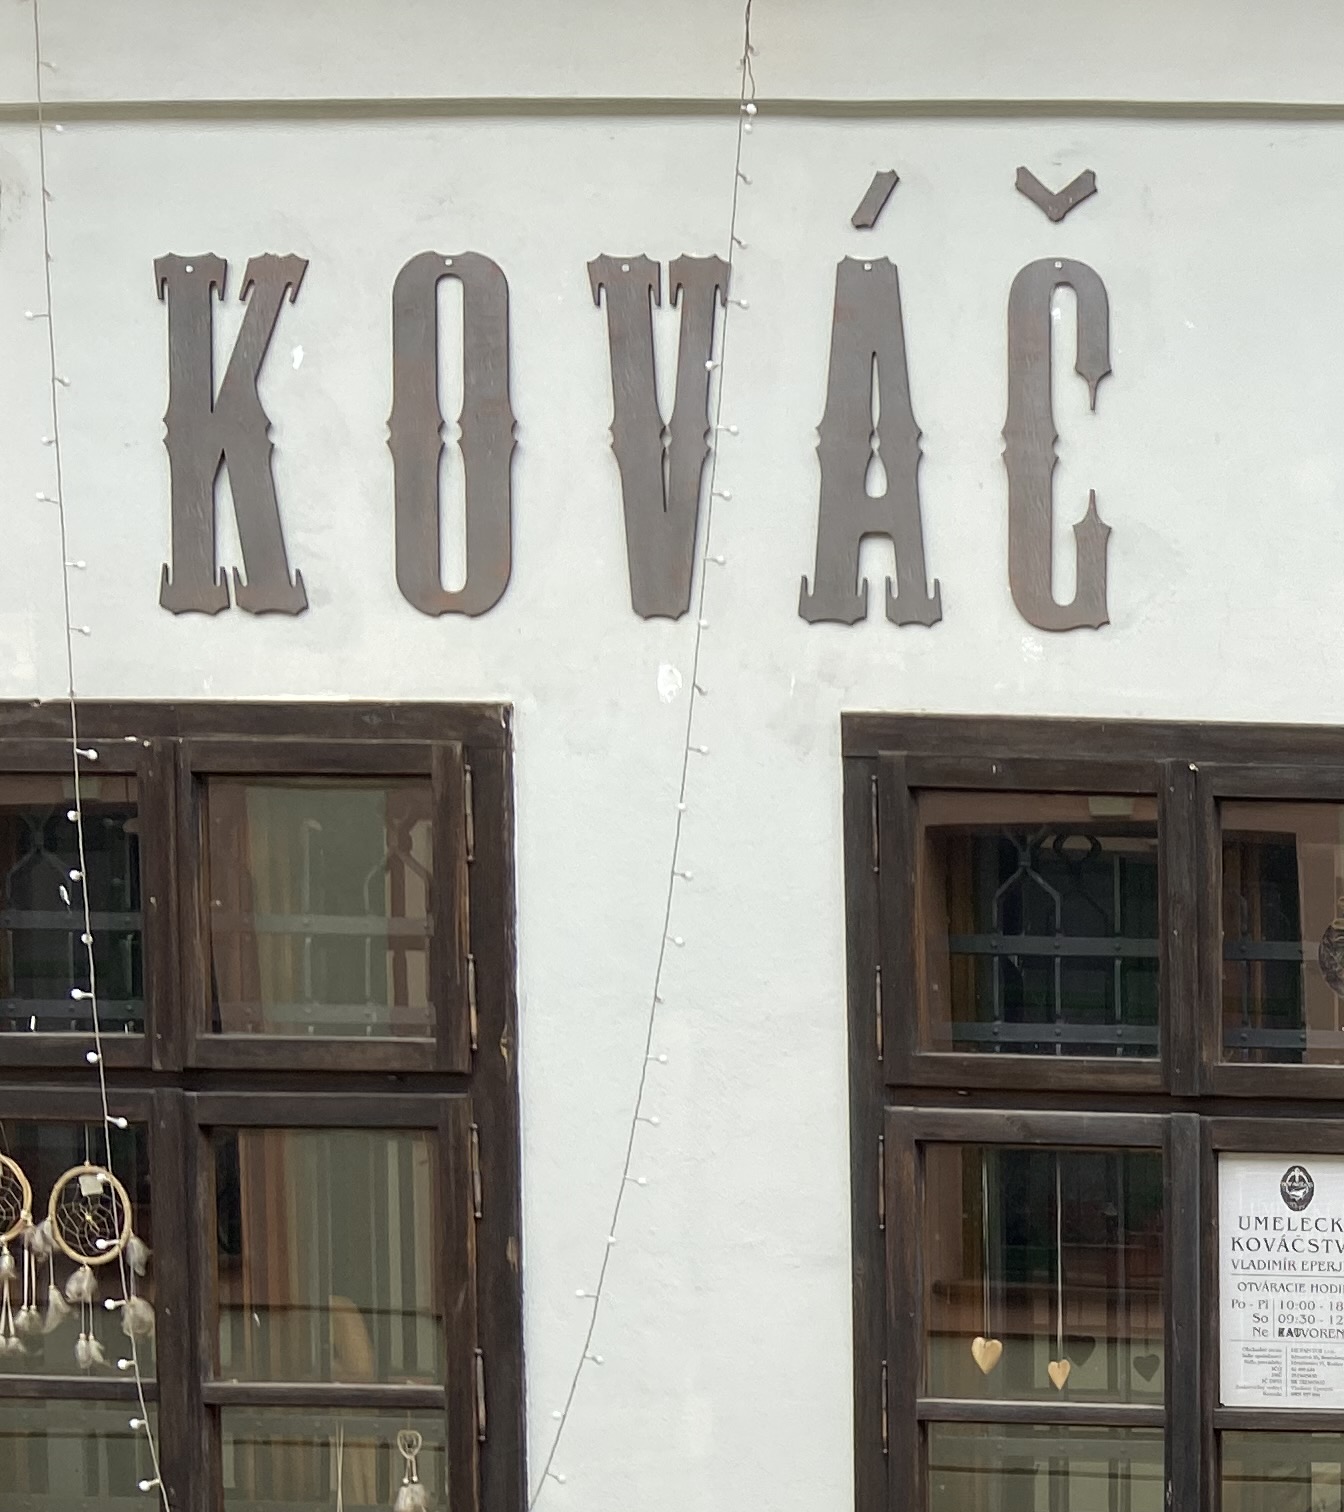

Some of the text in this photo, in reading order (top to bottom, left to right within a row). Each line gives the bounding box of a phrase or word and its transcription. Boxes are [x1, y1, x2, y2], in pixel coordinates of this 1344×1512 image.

[154, 166, 1112, 631] KOVÁČ
[1231, 1258, 1298, 1272] VLADIMÍR
[1237, 1281, 1306, 1294] OTVÁRACIE
[1231, 1299, 1247, 1310] Po
[1279, 1300, 1316, 1311] 10:00
[1252, 1313, 1269, 1324] So
[1277, 1313, 1316, 1325] 09:30
[1252, 1326, 1269, 1338] Ne
